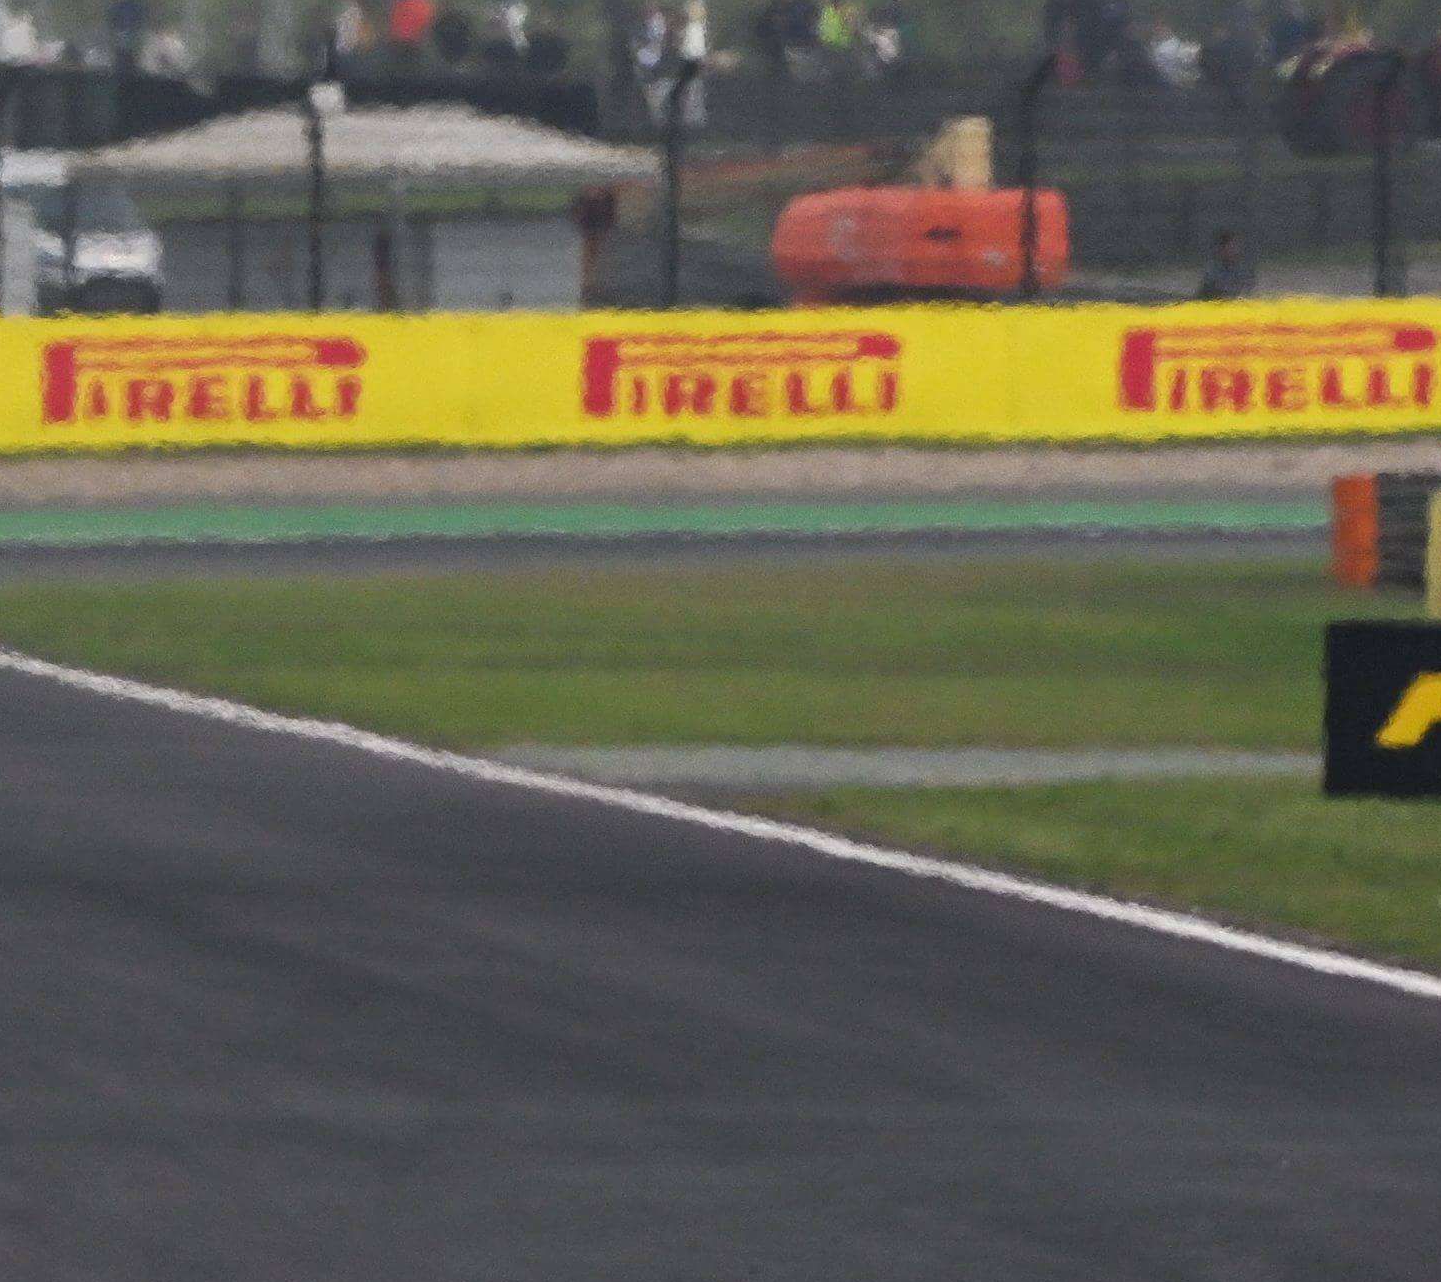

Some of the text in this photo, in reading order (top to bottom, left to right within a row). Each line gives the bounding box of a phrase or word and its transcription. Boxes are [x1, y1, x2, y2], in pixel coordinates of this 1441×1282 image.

[41, 336, 367, 423] PIRELLI
[582, 333, 901, 417] PIRELLI
[1119, 323, 1438, 412] PIRELLI
